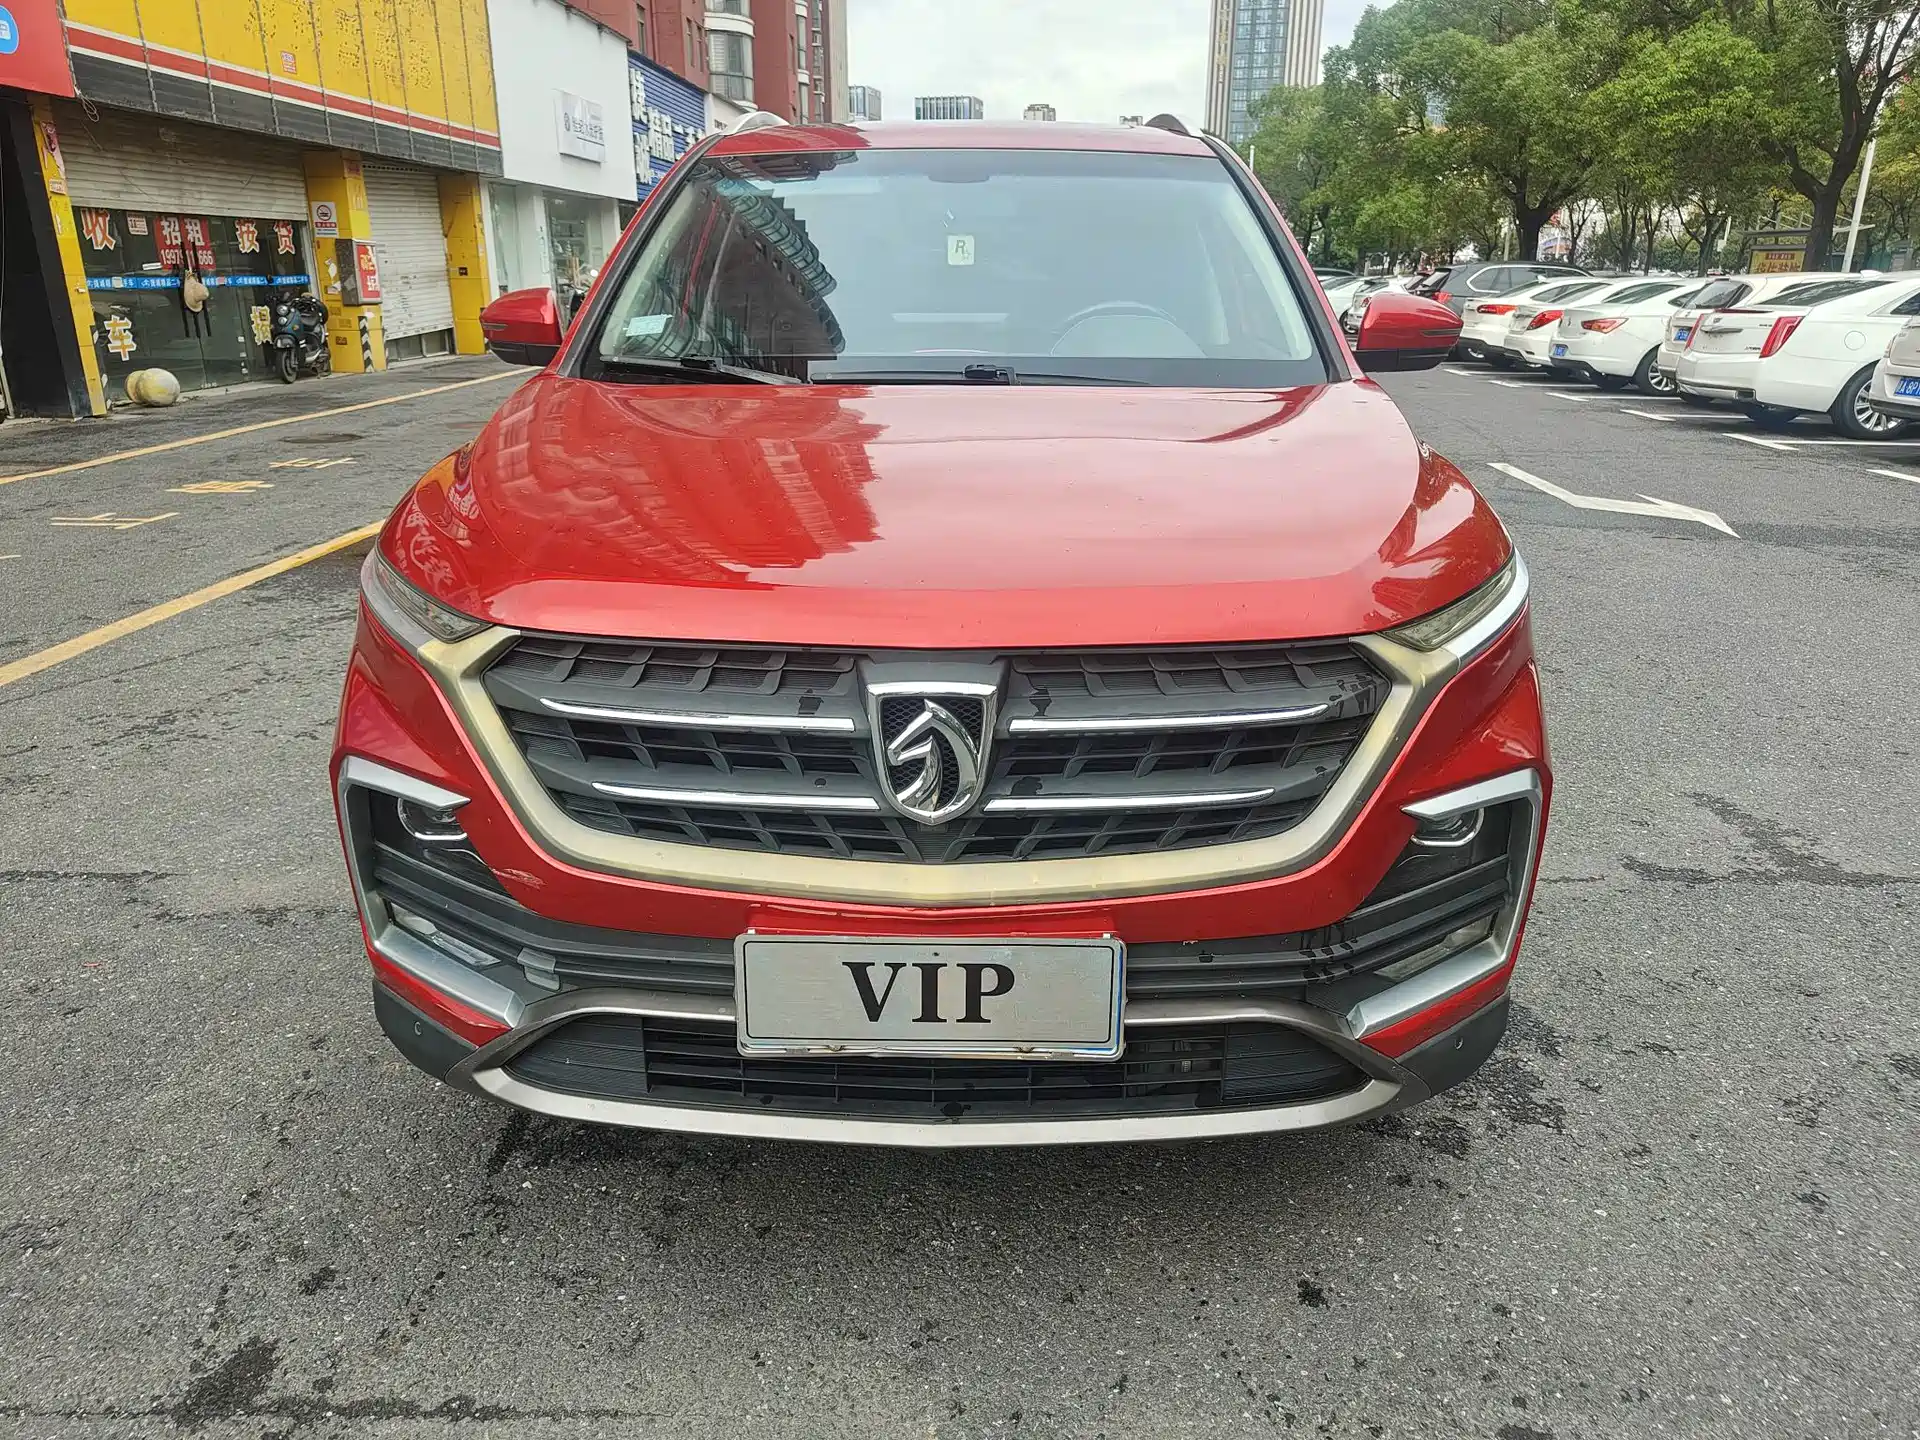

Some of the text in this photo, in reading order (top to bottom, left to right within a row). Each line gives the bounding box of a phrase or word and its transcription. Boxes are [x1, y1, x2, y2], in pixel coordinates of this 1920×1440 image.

[82, 208, 116, 250] 收
[161, 217, 205, 247] 招租
[235, 219, 260, 253] 按
[273, 220, 296, 254] 贷
[160, 249, 214, 266] 199711666
[104, 315, 136, 361] 车
[842, 961, 1015, 1023] VIP
